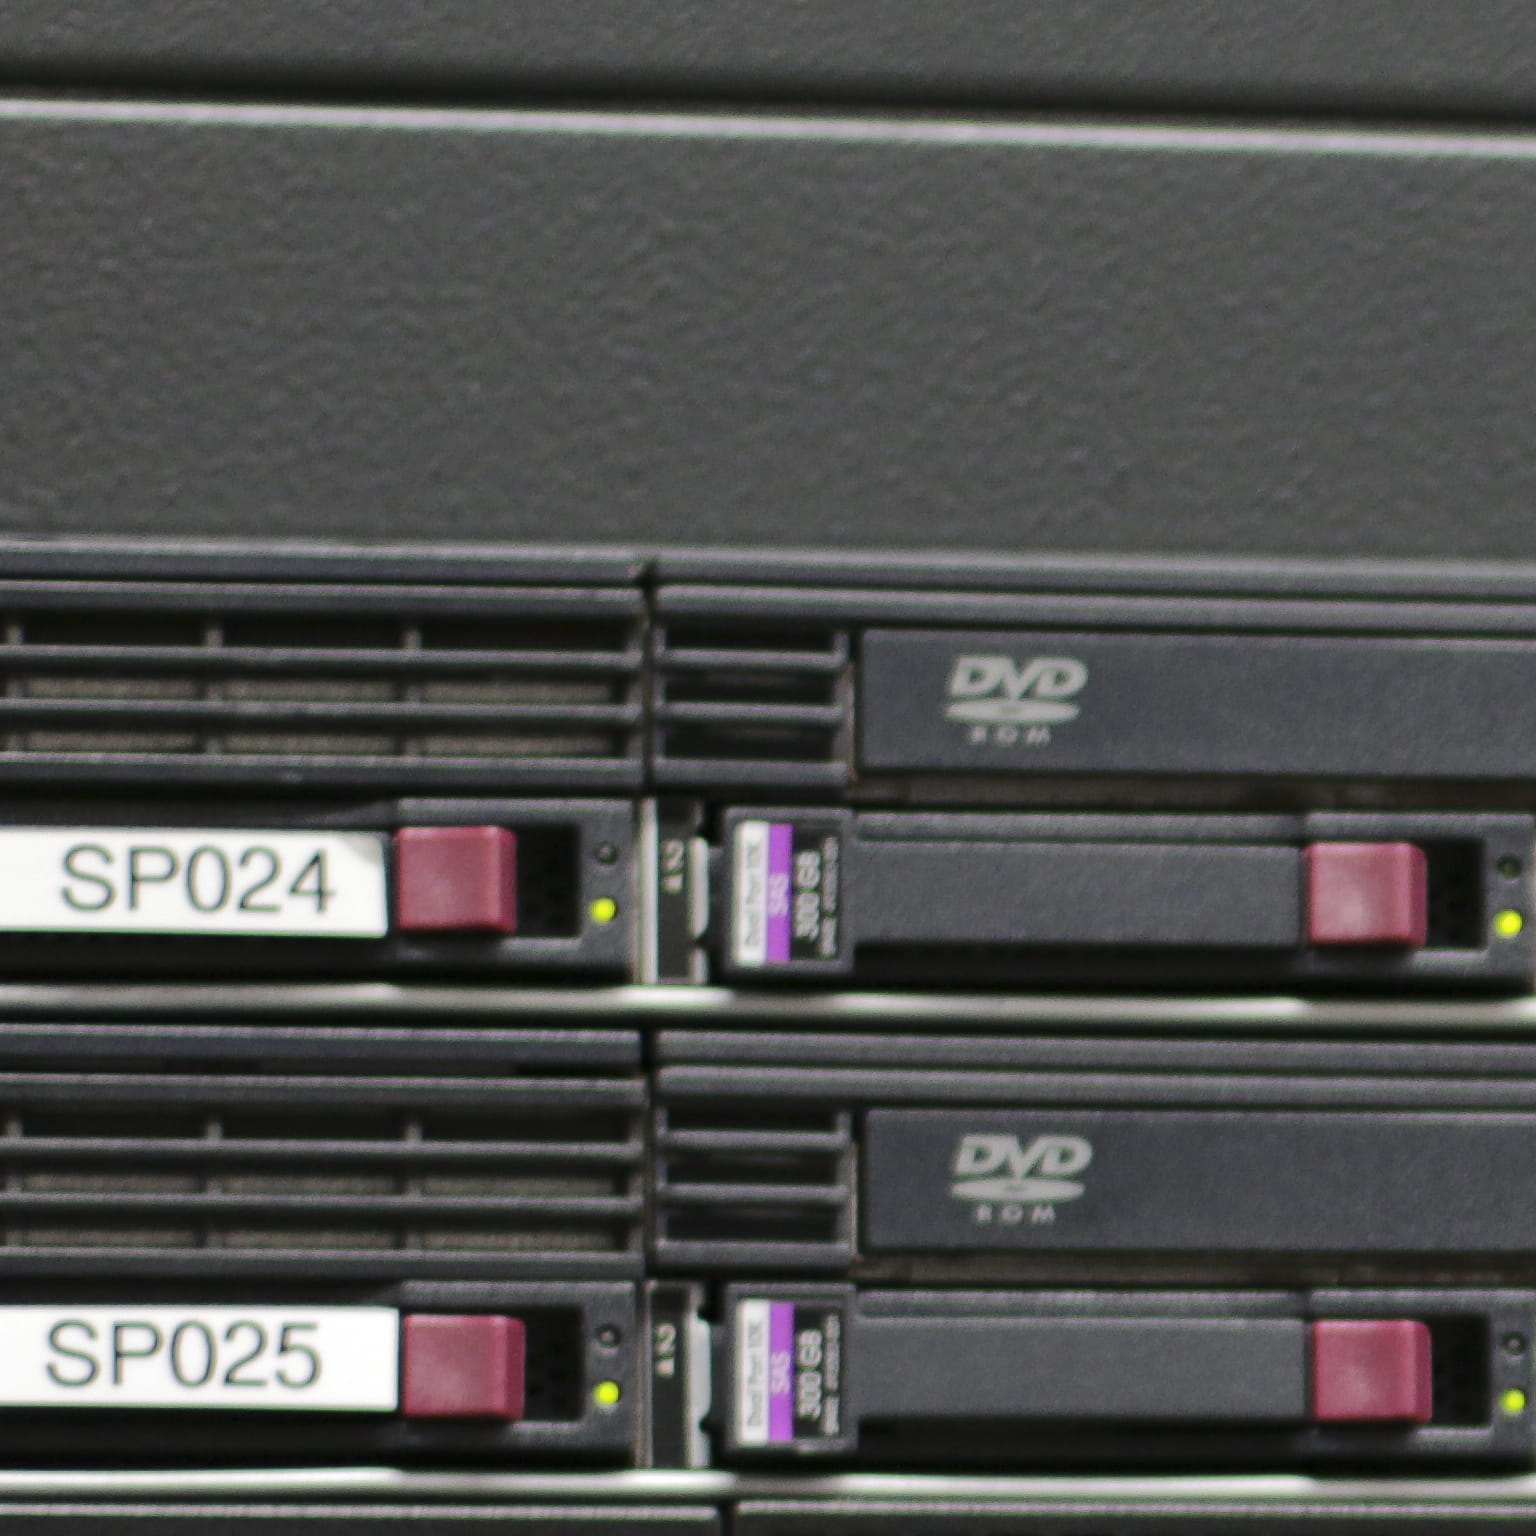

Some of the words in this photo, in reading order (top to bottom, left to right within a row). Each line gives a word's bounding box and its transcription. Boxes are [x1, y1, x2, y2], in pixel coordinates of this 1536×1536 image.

[951, 656, 1088, 698] DVD
[61, 843, 336, 912] SP024
[796, 851, 820, 890] GB
[770, 874, 790, 916] SAS
[796, 893, 820, 941] 300
[956, 1134, 1092, 1178] DVD
[45, 1321, 321, 1388] SP025
[799, 1330, 822, 1367] GB
[770, 1352, 790, 1394] SAS
[799, 1371, 822, 1419] 300
